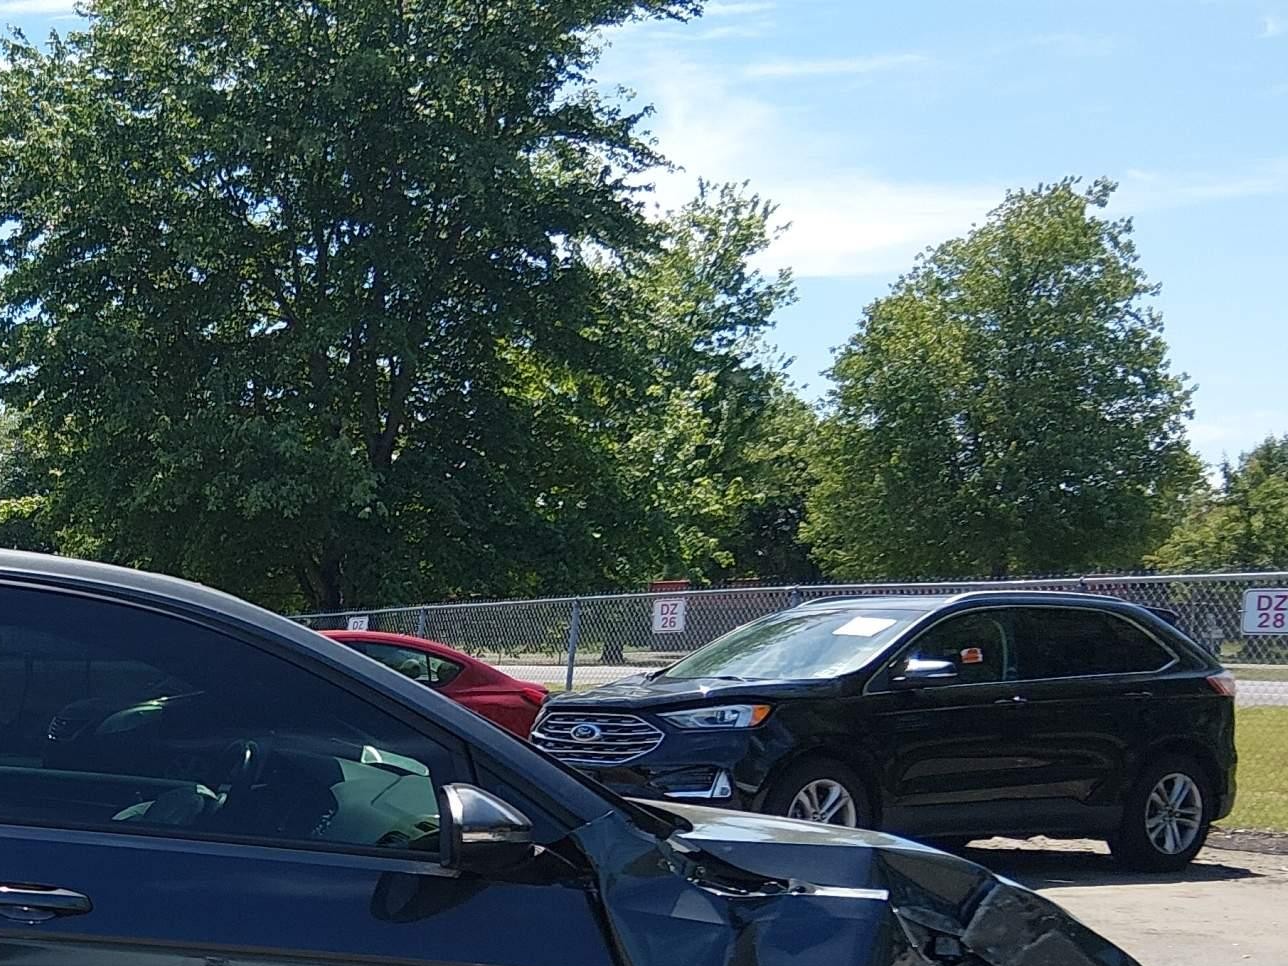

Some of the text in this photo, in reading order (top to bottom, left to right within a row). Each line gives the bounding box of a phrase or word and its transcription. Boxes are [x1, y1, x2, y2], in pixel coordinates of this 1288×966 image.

[660, 603, 678, 616] DZ
[1256, 595, 1288, 611] DZ
[661, 616, 677, 628] 26
[1257, 612, 1285, 628] 28
